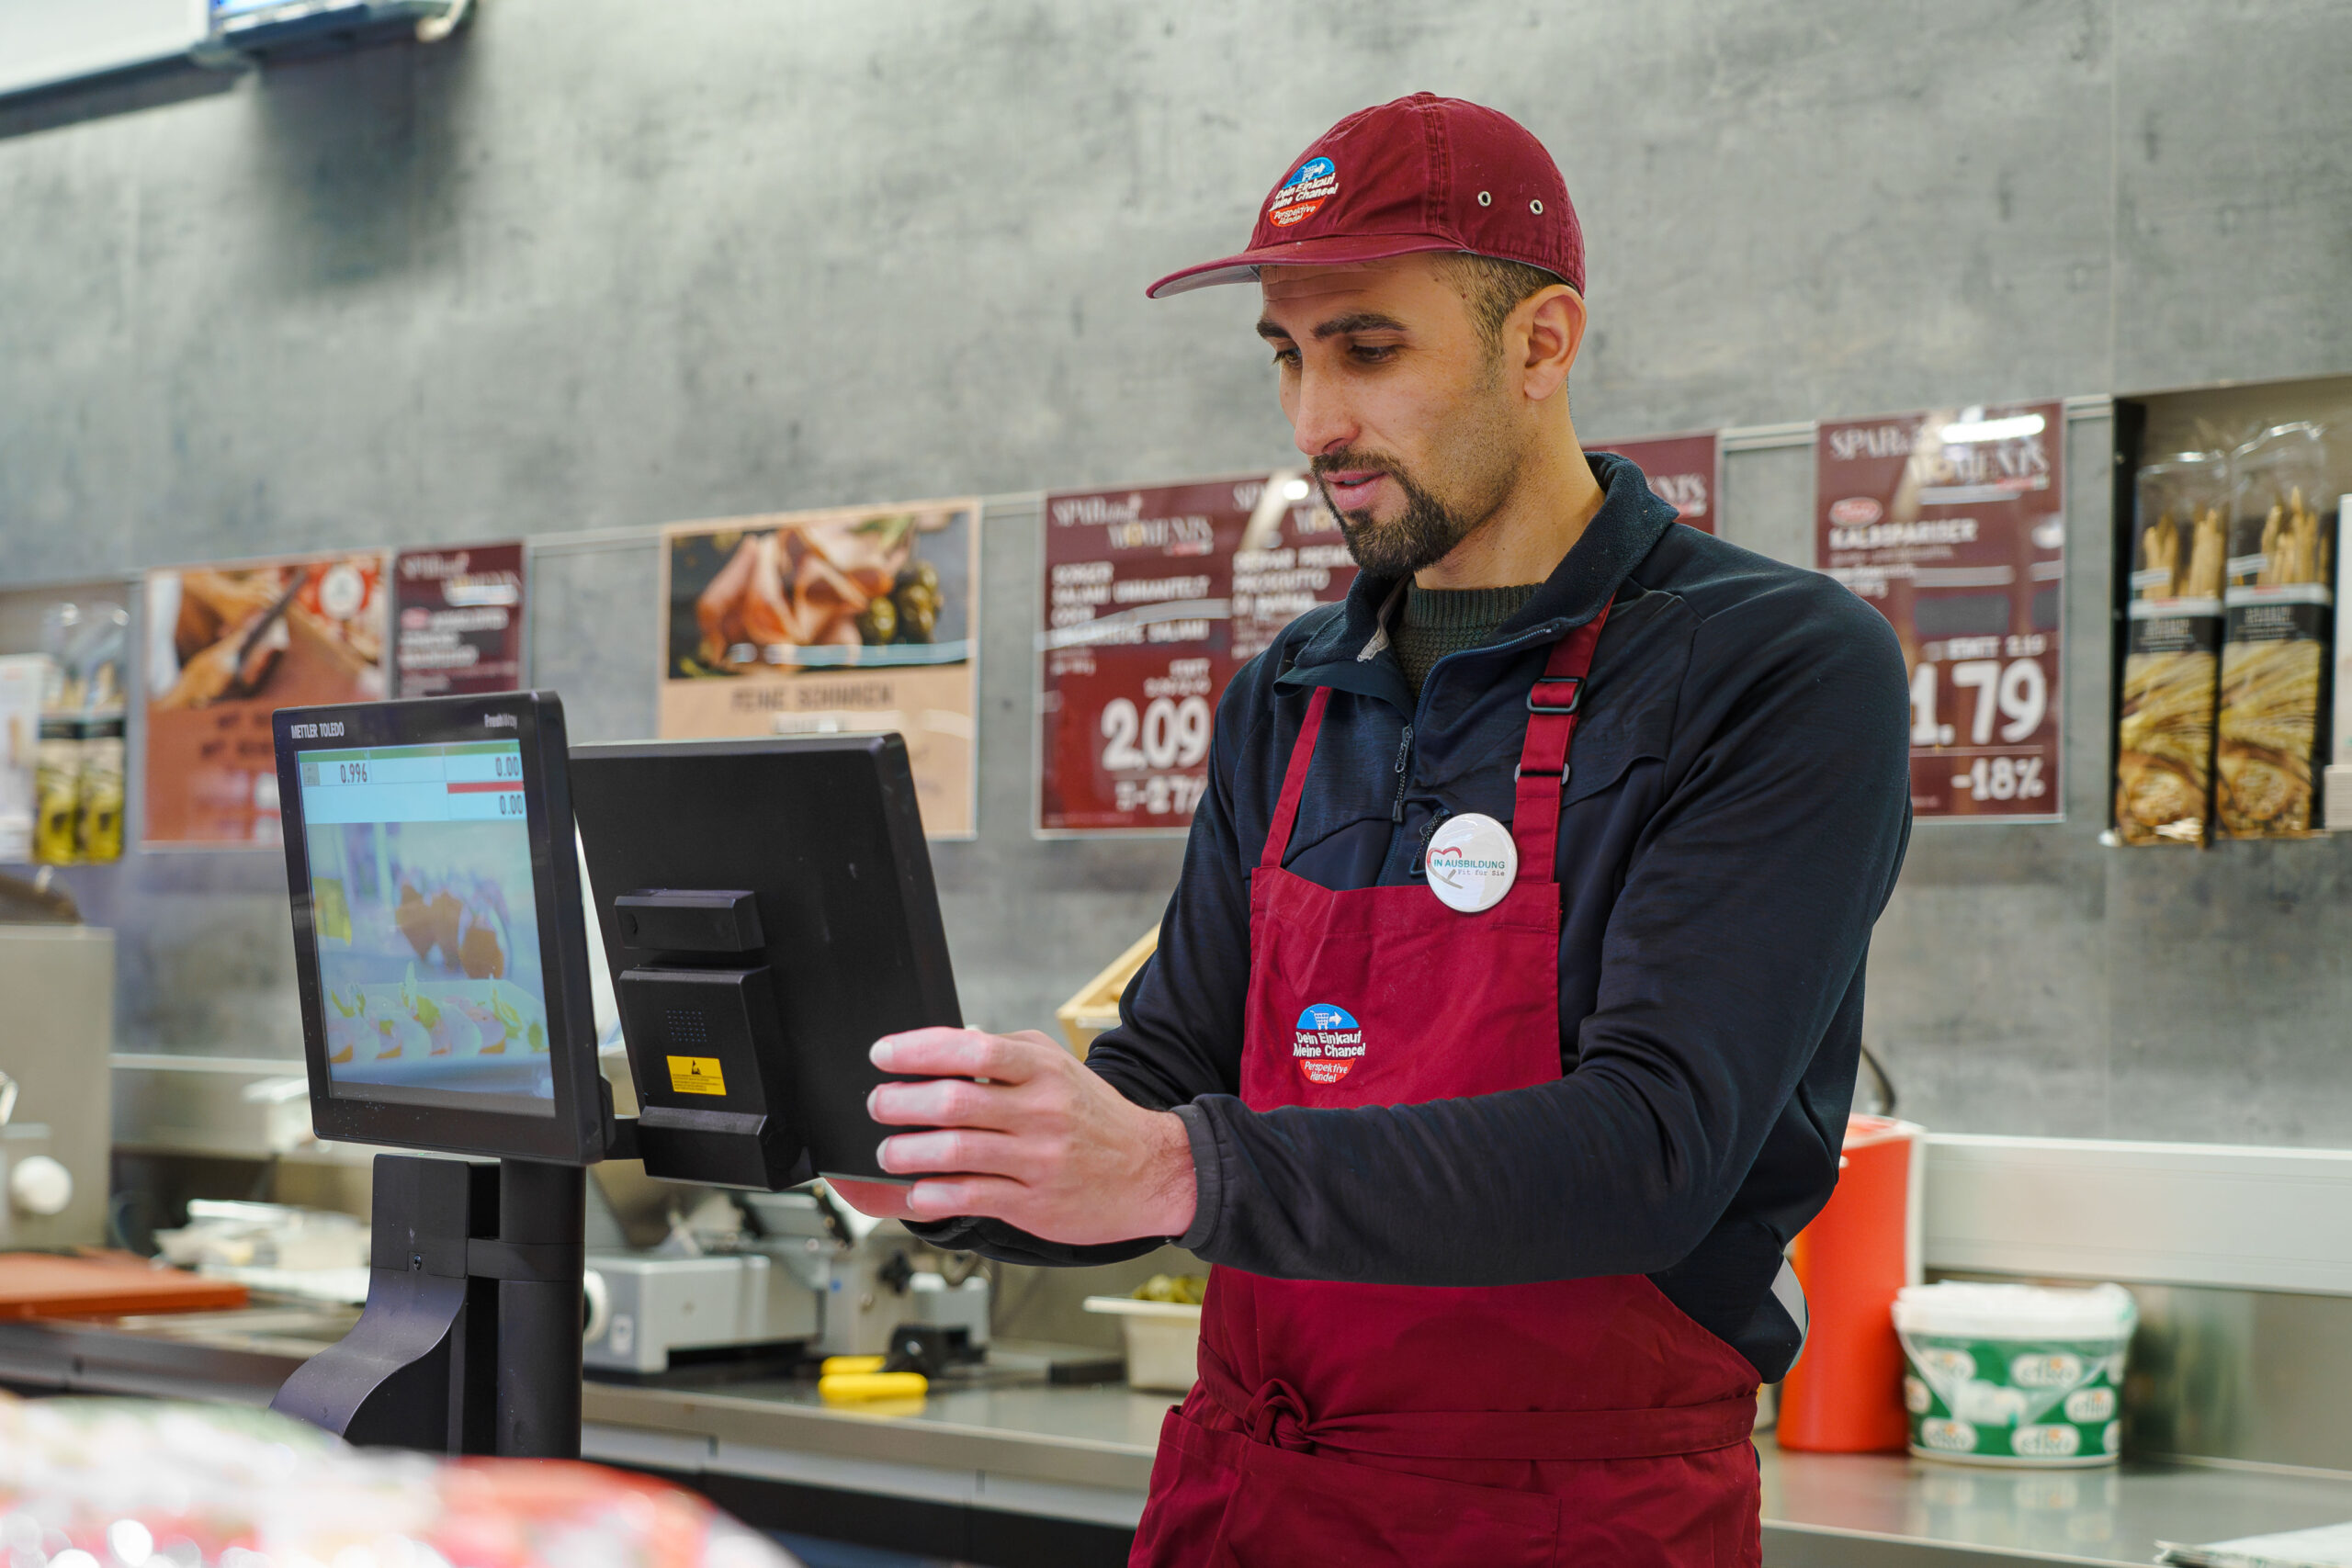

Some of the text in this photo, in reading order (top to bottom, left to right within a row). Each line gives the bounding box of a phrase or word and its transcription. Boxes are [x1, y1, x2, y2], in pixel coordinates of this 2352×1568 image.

[1275, 172, 1336, 199] Dein Einkauf
[1273, 203, 1316, 220] Perspektive
[1910, 658, 2047, 746] 1.79
[291, 721, 345, 739] METTLER TOLEDO
[1102, 695, 1211, 771] 2.09
[340, 762, 368, 784] 0.996
[495, 756, 519, 777] 0.00
[1951, 756, 2045, 800] -18%
[500, 795, 524, 815] 0.00
[1434, 859, 1505, 869] IN AUSBILDUNG
[1295, 1030, 1362, 1044] Dein Einkauf
[1293, 1043, 1366, 1057] Meine Chance!
[1305, 1061, 1348, 1074] Perspektive
[1310, 1071, 1337, 1083] Handel
